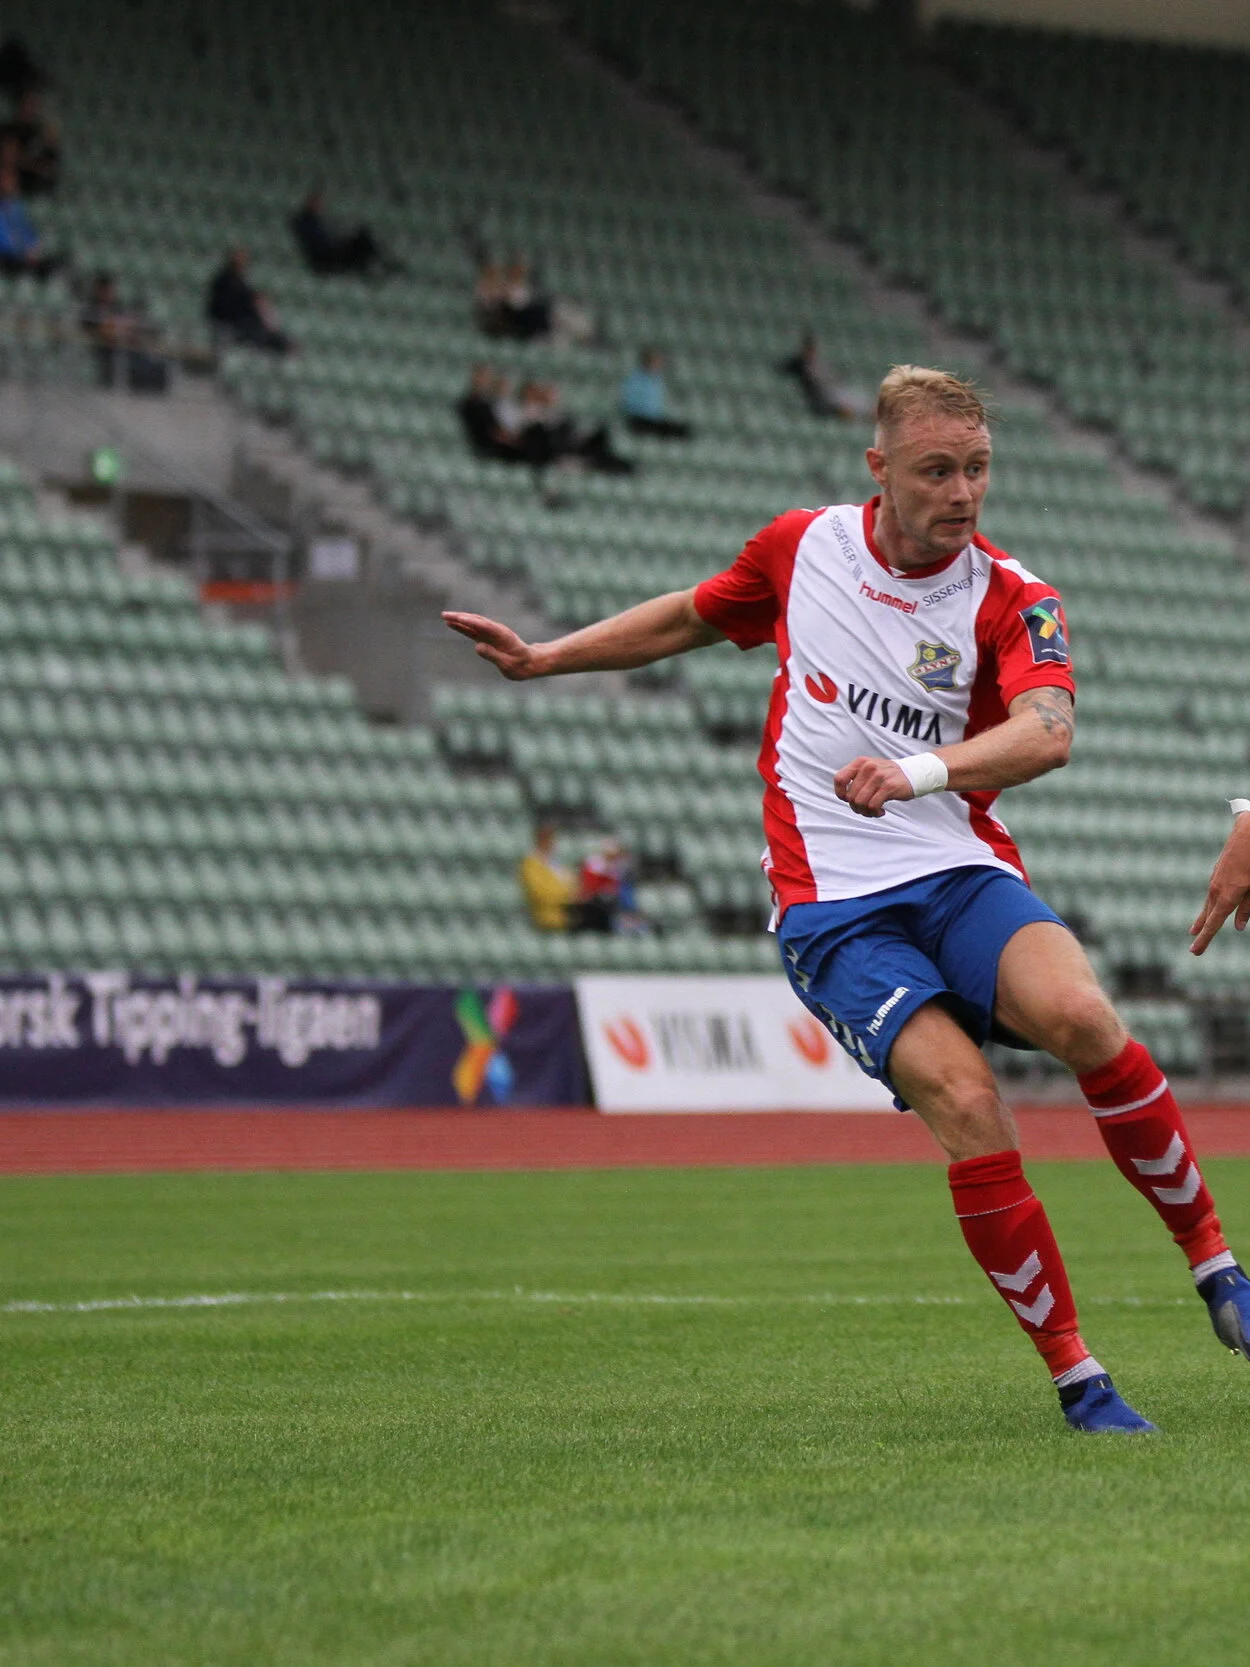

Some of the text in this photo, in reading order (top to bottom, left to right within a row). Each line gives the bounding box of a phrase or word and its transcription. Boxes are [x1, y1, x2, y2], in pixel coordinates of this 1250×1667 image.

[829, 514, 857, 564] SISSENER
[859, 580, 918, 615] hummel
[848, 683, 942, 746] VISMA
[866, 986, 910, 1036] hummel
